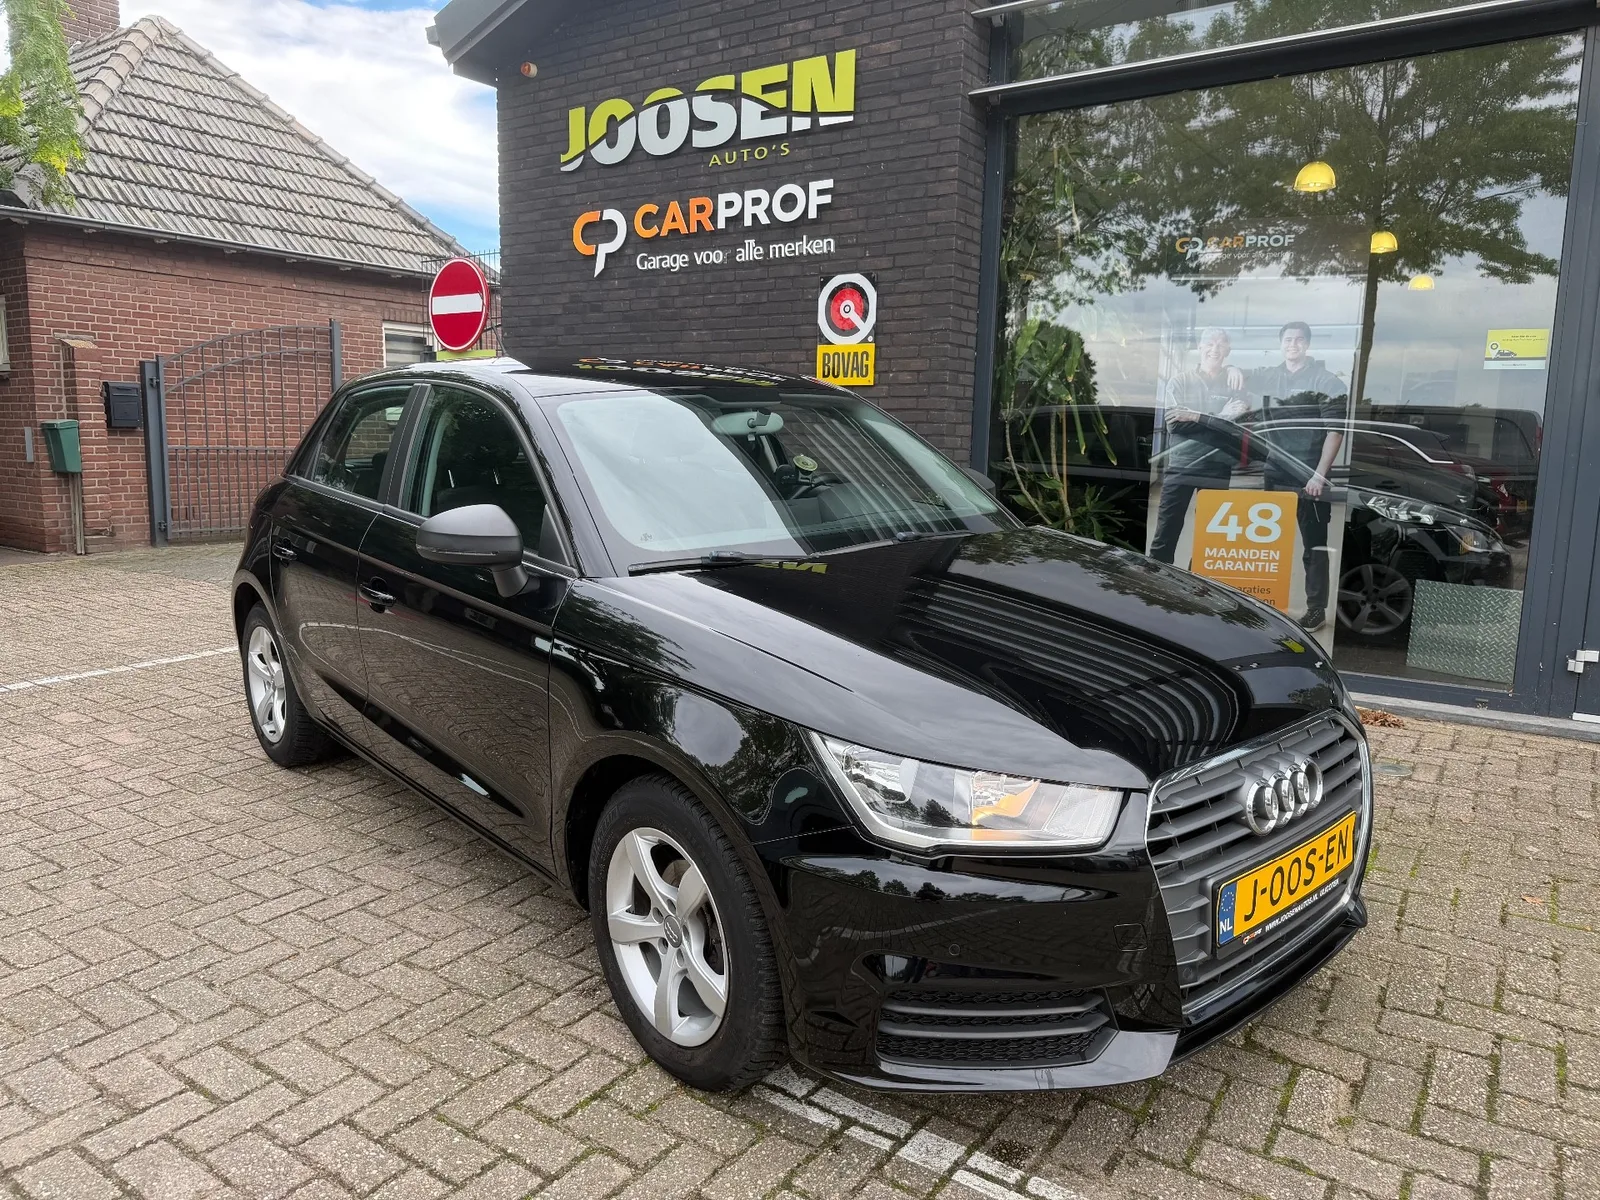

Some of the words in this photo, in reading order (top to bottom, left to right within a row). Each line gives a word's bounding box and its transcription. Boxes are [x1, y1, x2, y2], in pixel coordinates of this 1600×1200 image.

[560, 48, 856, 172] JOOSEN
[708, 142, 790, 167] AUTO'S
[633, 178, 834, 239] CARPROF
[636, 252, 689, 272] Garage
[769, 234, 836, 259] merken
[1207, 234, 1296, 249] CARPROF
[822, 351, 870, 379] BOVAG
[1205, 501, 1282, 543] 48
[1203, 559, 1279, 573] GARANTIE
[1204, 547, 1280, 561] MAANDEN
[1219, 917, 1233, 935] NL
[1243, 824, 1349, 922] J-OOS-EN
